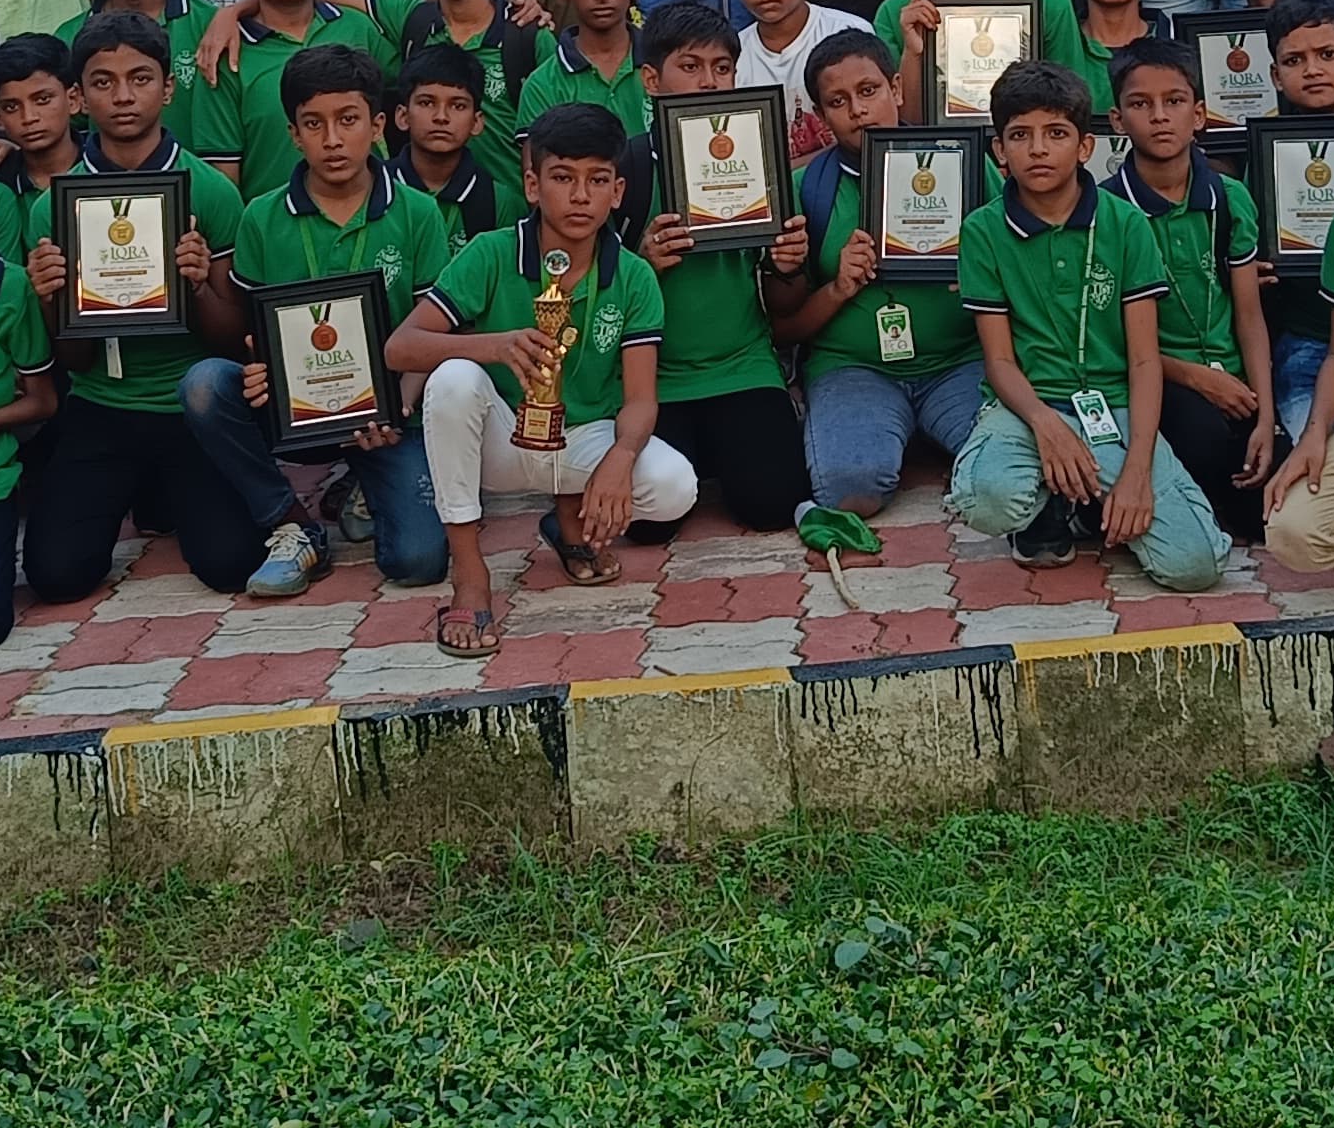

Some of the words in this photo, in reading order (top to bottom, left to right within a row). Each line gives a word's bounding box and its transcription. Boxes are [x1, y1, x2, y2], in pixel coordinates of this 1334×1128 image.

[972, 58, 1007, 70] IQRA
[1229, 72, 1263, 85] IQRA
[712, 159, 749, 174] IQRA
[913, 195, 948, 209] IQRA
[110, 245, 149, 261] IQRA
[315, 349, 355, 366] IQRA
